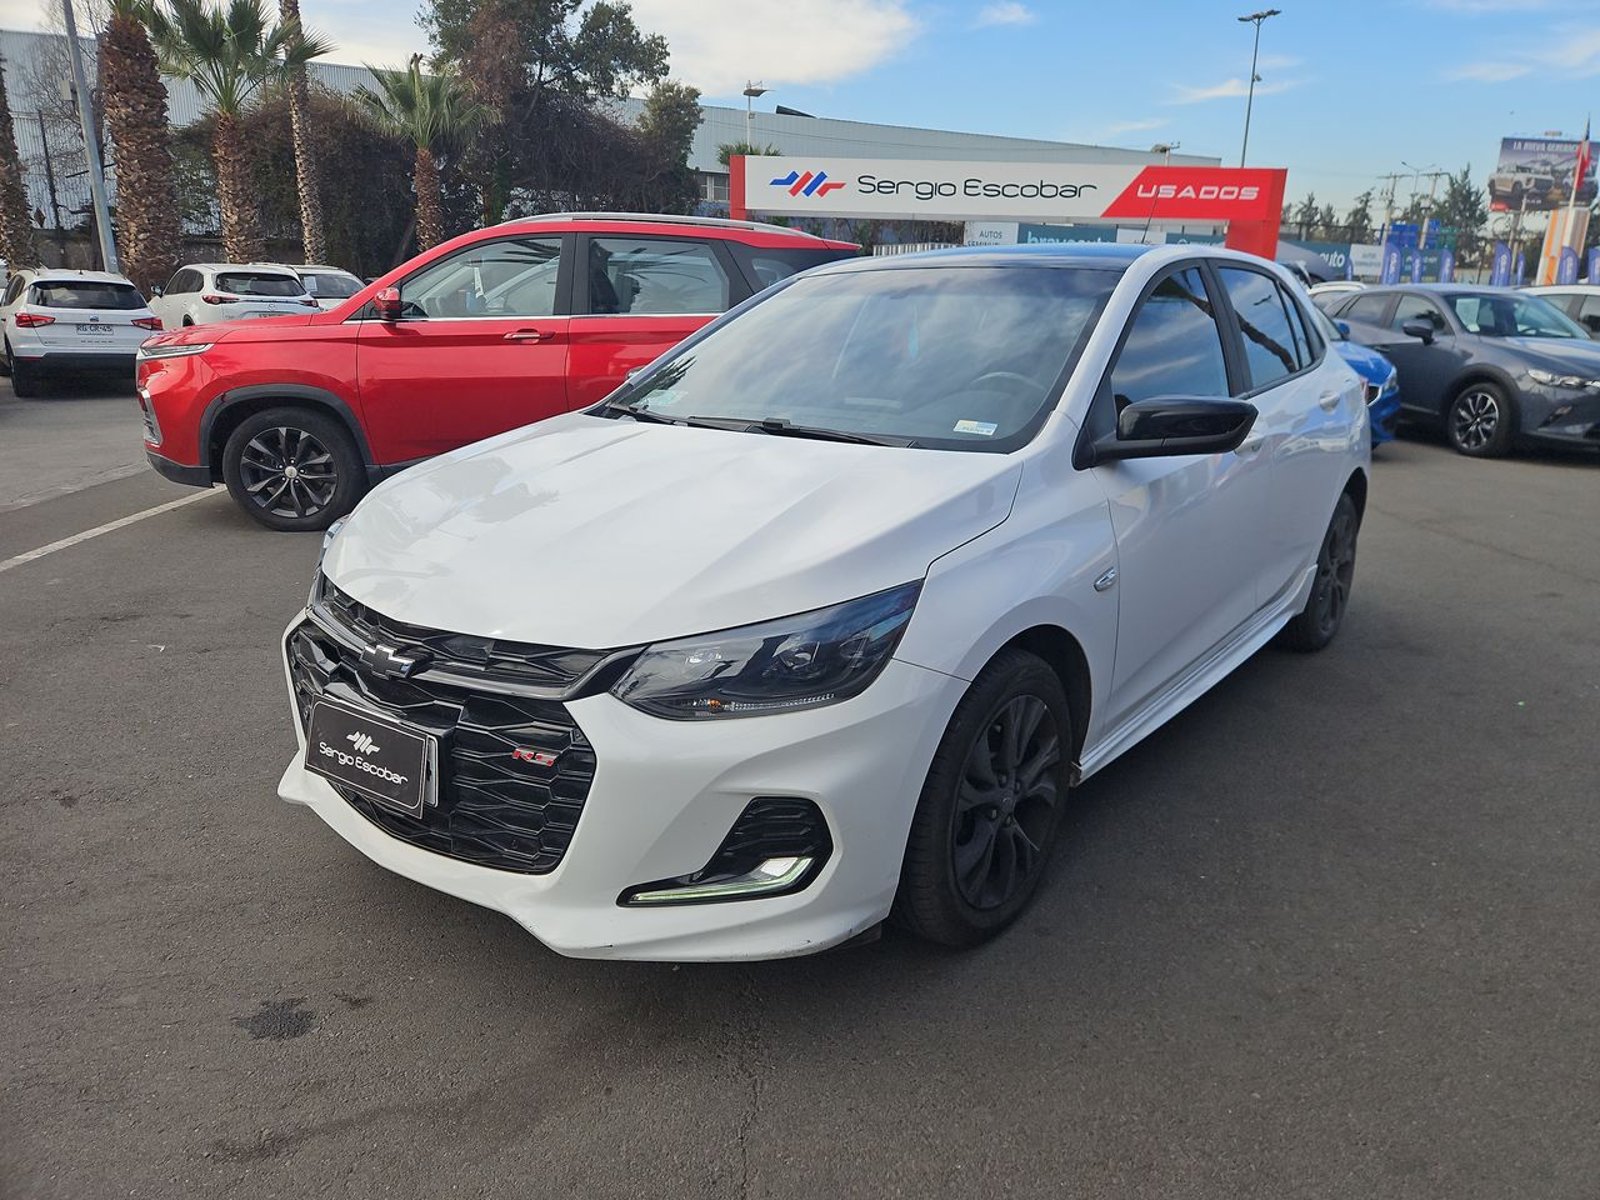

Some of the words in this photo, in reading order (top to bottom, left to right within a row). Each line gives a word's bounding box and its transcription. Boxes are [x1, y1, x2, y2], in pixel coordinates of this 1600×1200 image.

[857, 174, 957, 201] Sergio
[963, 178, 1098, 199] Escobar
[1136, 184, 1260, 200] USADOS
[979, 230, 1003, 240] AUTOS
[319, 741, 354, 765] Sergio
[355, 756, 409, 785] Escobar
